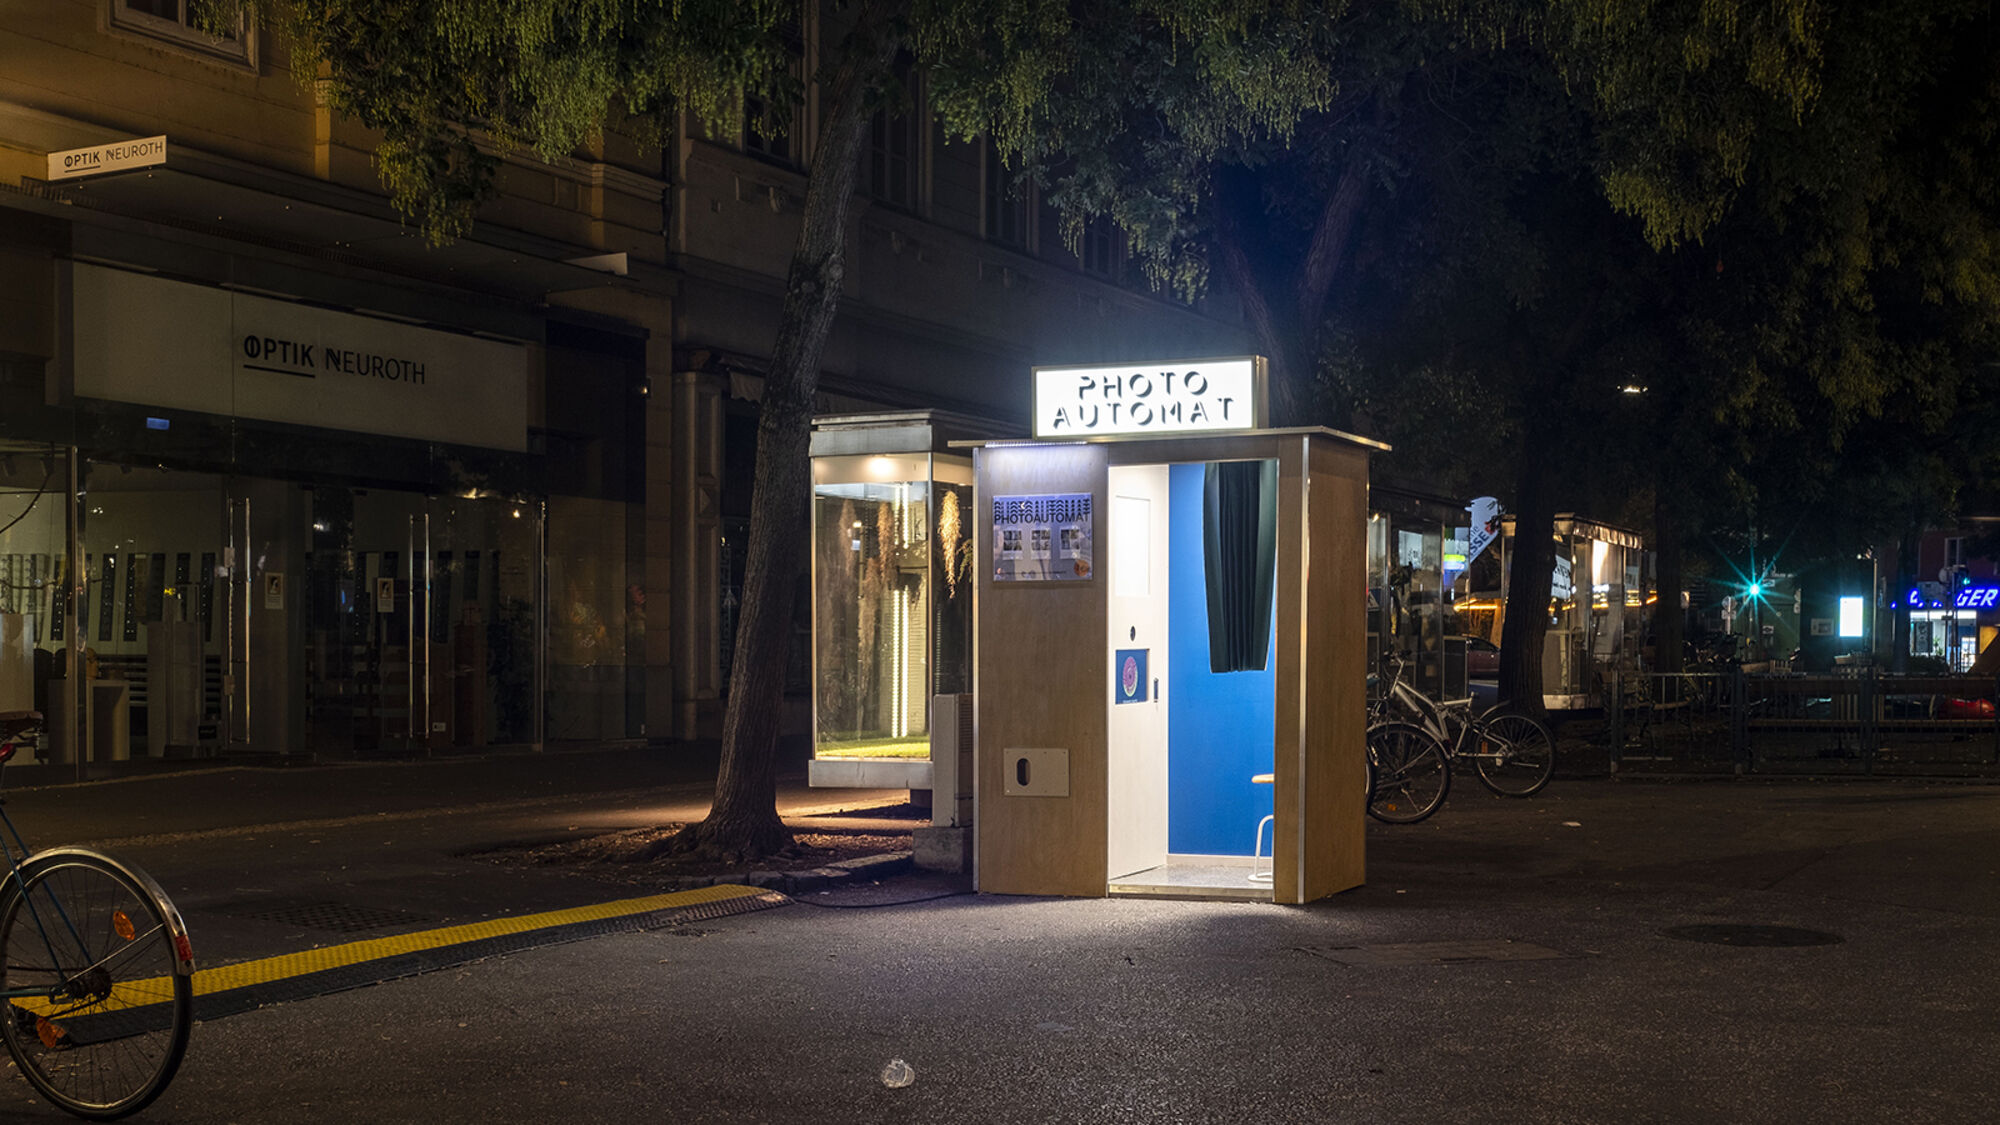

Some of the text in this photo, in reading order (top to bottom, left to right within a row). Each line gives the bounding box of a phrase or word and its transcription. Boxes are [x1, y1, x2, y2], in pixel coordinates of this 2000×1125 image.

[64, 141, 163, 168] OPTIK NEUROTH
[244, 335, 425, 385] OPTIK NEUROTH
[1079, 371, 1208, 400] PHOTO
[1053, 398, 1234, 429] AUTOMAT
[994, 510, 1090, 524] PHOTOAUTOMAT
[1469, 531, 1490, 556] SSE
